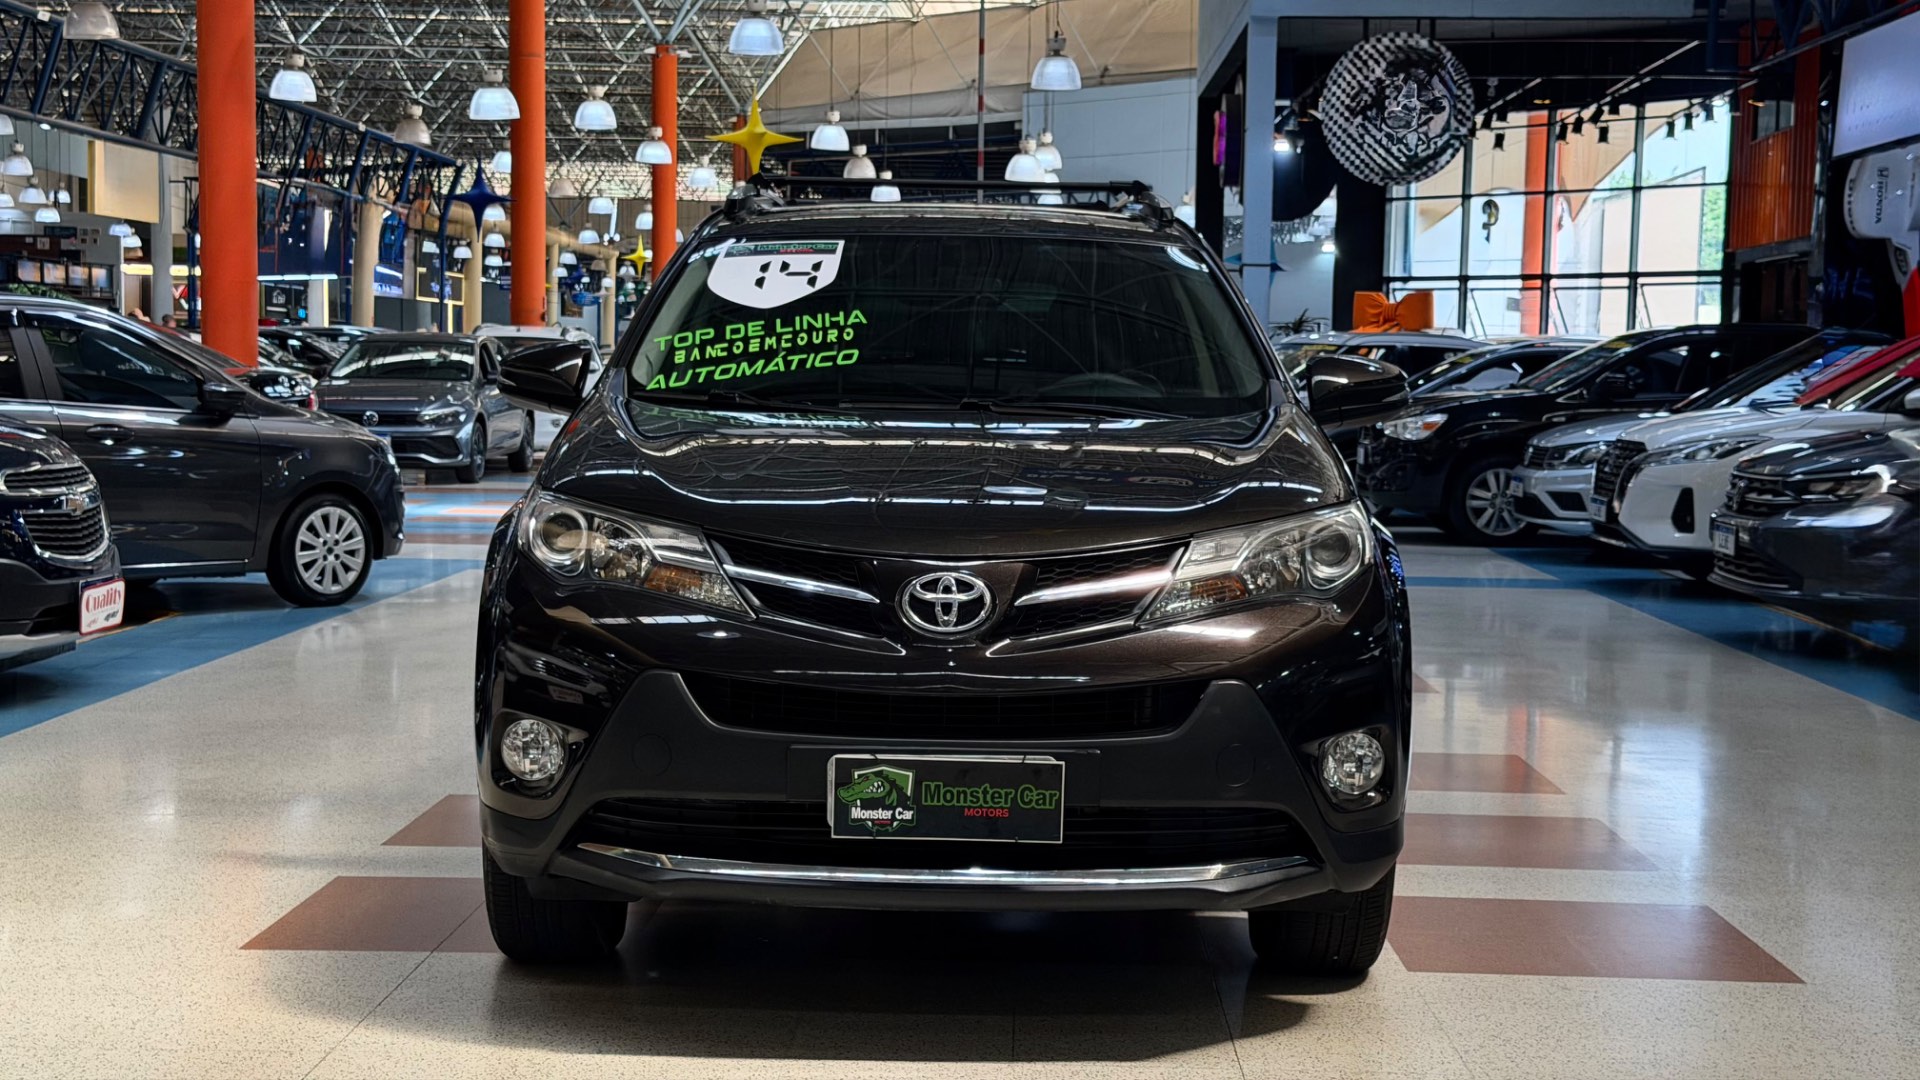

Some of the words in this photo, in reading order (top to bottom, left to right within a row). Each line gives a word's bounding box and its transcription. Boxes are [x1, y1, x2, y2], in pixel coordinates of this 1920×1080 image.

[1875, 181, 1884, 225] HONDA
[754, 260, 824, 290] 14
[653, 328, 715, 352] TOP
[725, 320, 766, 341] DE
[775, 309, 868, 333] LINHA
[645, 349, 860, 390] AUTOMÁTICO
[921, 781, 1014, 808] Monster
[1017, 785, 1060, 810] Car
[851, 806, 893, 820] Monster
[895, 807, 914, 820] Car
[964, 807, 1010, 818] MOTORS
